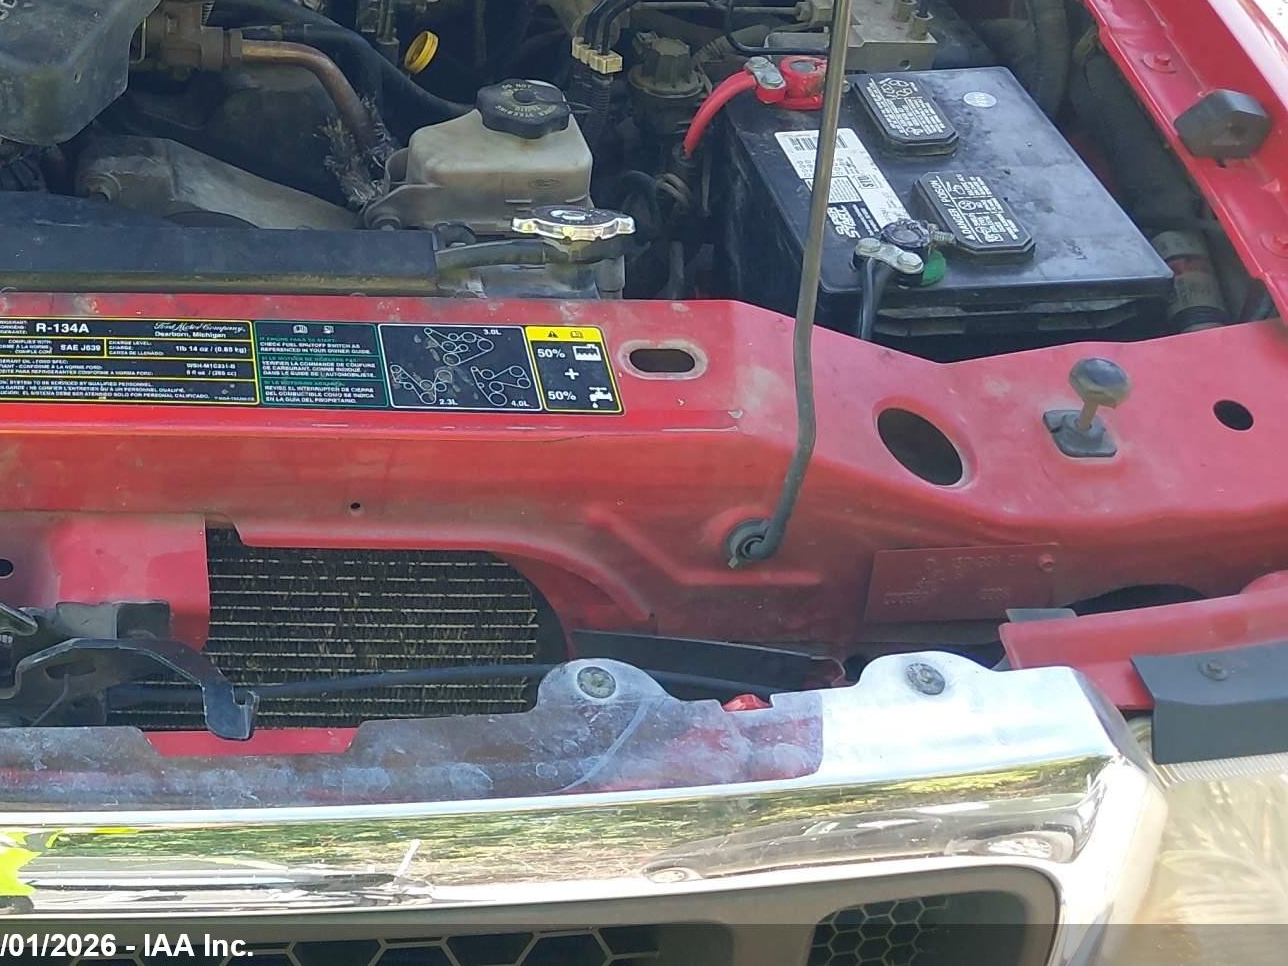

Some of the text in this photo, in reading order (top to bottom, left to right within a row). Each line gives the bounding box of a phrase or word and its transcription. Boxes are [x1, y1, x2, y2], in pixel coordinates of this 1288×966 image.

[928, 180, 951, 203] POISON
[948, 207, 972, 234] DANGER
[36, 322, 90, 334] R-134A
[537, 348, 566, 358] 50%
[548, 391, 576, 401] 50%
